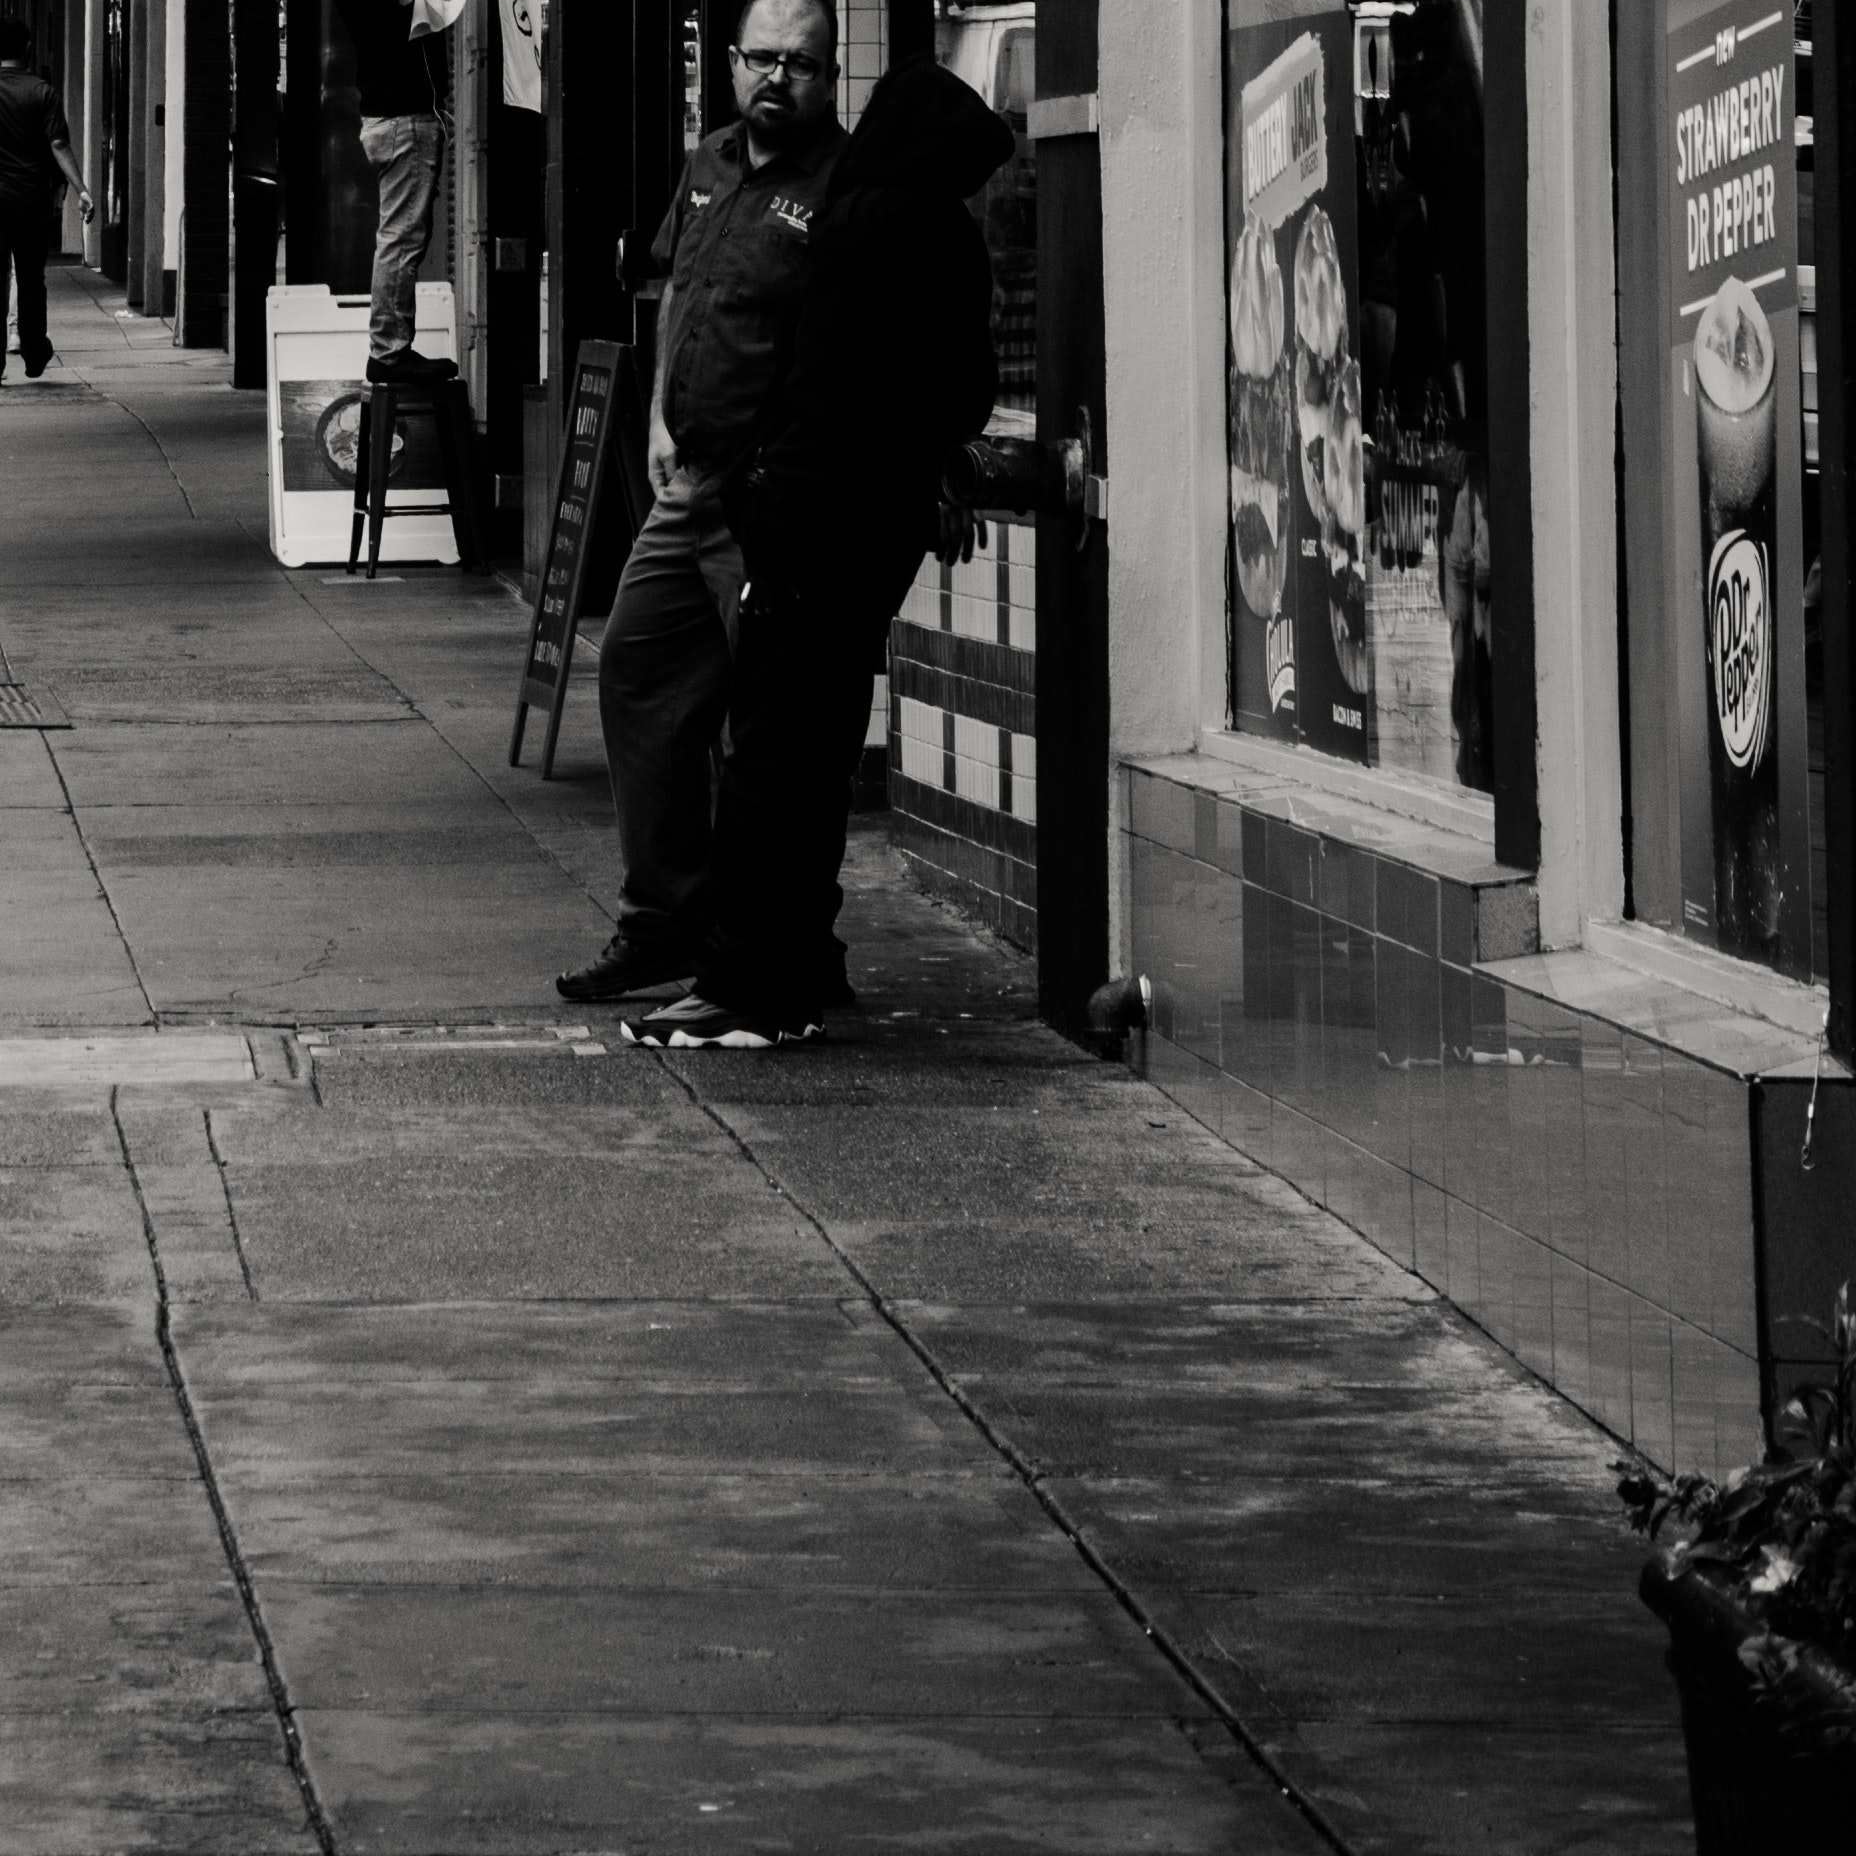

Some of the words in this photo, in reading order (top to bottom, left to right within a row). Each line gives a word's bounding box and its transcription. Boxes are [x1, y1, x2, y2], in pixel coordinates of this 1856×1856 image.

[1247, 91, 1288, 202] BUTTERY
[1291, 68, 1318, 163] JACK
[1677, 64, 1784, 185] STRAWBERRY
[1687, 192, 1711, 272] DR
[1713, 164, 1776, 261] PEPPER
[1381, 479, 1439, 556] SUMMER
